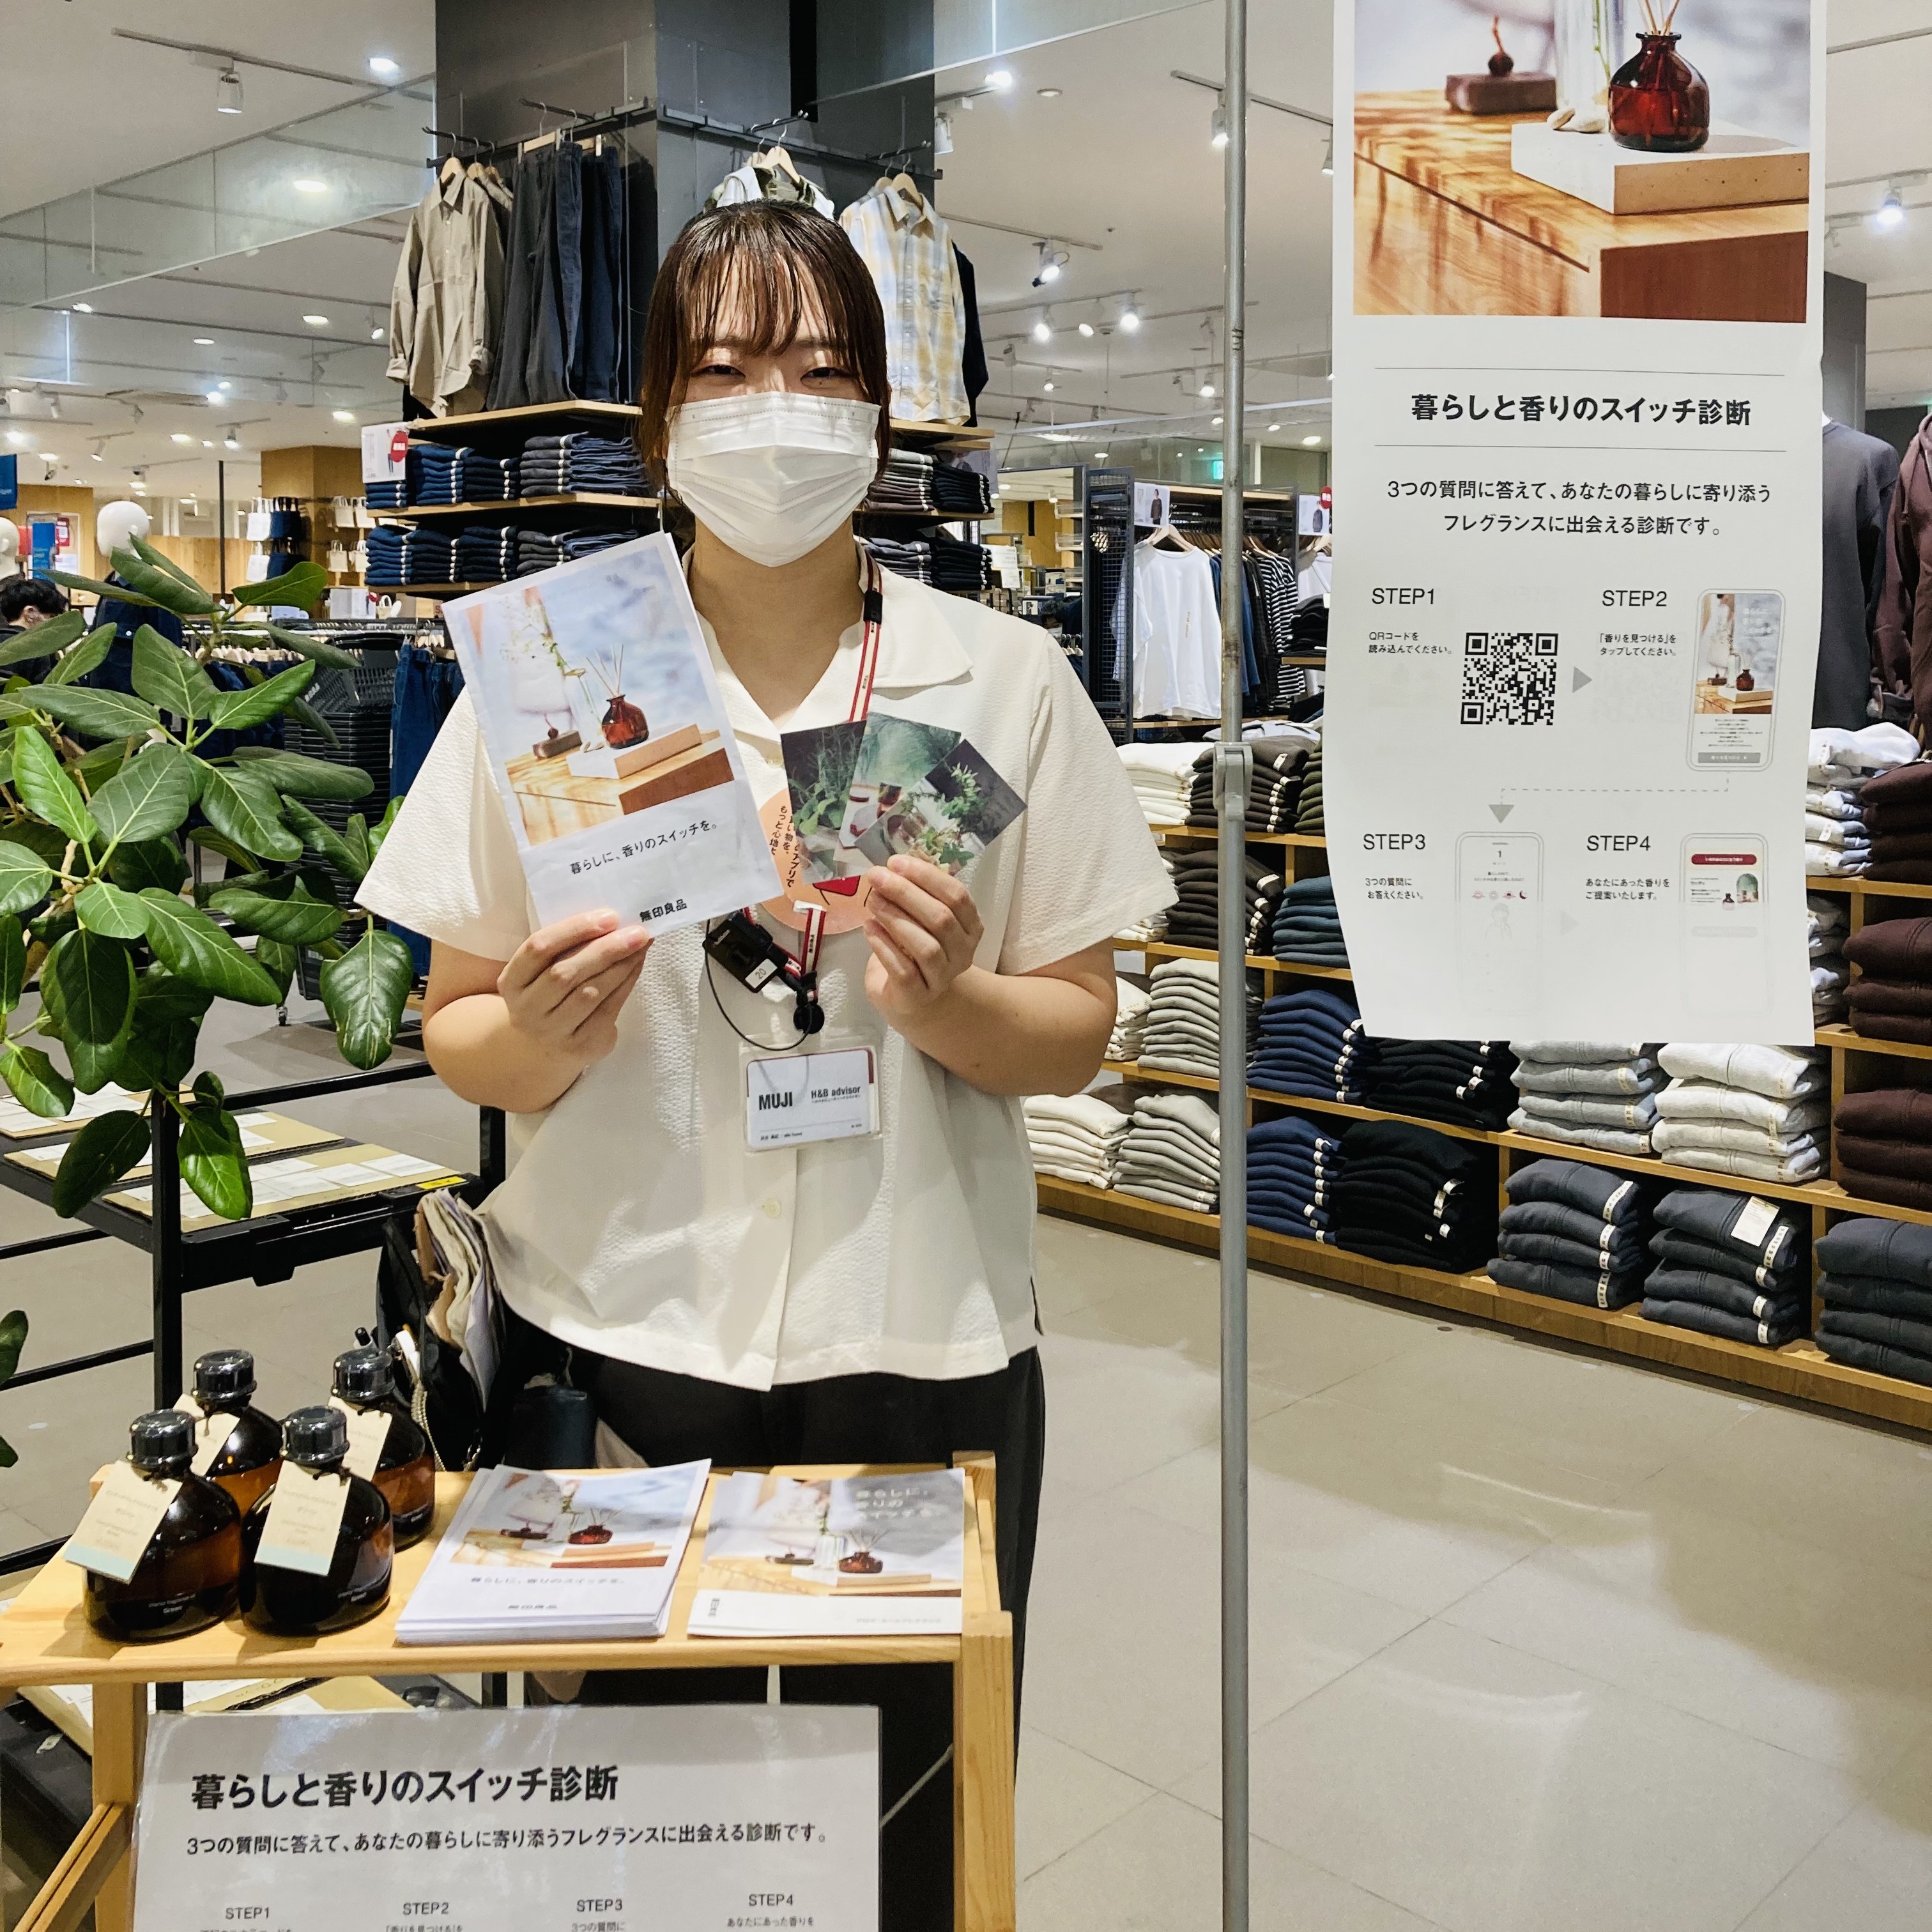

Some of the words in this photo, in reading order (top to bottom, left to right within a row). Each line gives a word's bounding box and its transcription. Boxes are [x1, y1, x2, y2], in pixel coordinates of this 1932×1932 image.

[1411, 394, 1751, 425] 暮らしと香りのスイッチ診断
[1388, 480, 1770, 503] 3つの質問に答えて、あなたの暮らしに寄り添う
[1444, 514, 1721, 535] フレグランスに出会える診断です。
[1372, 587, 1435, 604] STEP1
[1602, 590, 1667, 607] STEP2
[1369, 631, 1419, 641] QRコードを
[1600, 632, 1676, 644] 「香りを見つける」を
[1368, 644, 1452, 654] 読み込んでください。
[1600, 647, 1676, 656] タップしてください。
[571, 819, 717, 875] 暮らしに、香りのスイッチを。
[1363, 833, 1425, 850] STEP3
[1586, 835, 1651, 852] STEP4
[1365, 878, 1412, 887] 3つの質問に
[1586, 878, 1670, 887] あなたにあった香りを
[1367, 891, 1423, 900] お答えください。
[1586, 891, 1657, 900] ご提案いたします。
[639, 898, 688, 923] 無印良品
[755, 968, 767, 980] 20
[811, 1088, 829, 1099] H&B
[831, 1086, 861, 1096] advisor
[758, 1092, 793, 1110] MUJI
[192, 1765, 618, 1811] 暮らしと香りのスイッチ診断
[187, 1822, 826, 1855] 3つの質問に答えて、あなたの暮らしに寄り添うフレグランスに出会える診断です。
[577, 1899, 623, 1912] STEP3
[749, 1894, 793, 1906] STEP4
[226, 1906, 270, 1920] STEP1
[403, 1902, 449, 1915] STEP2
